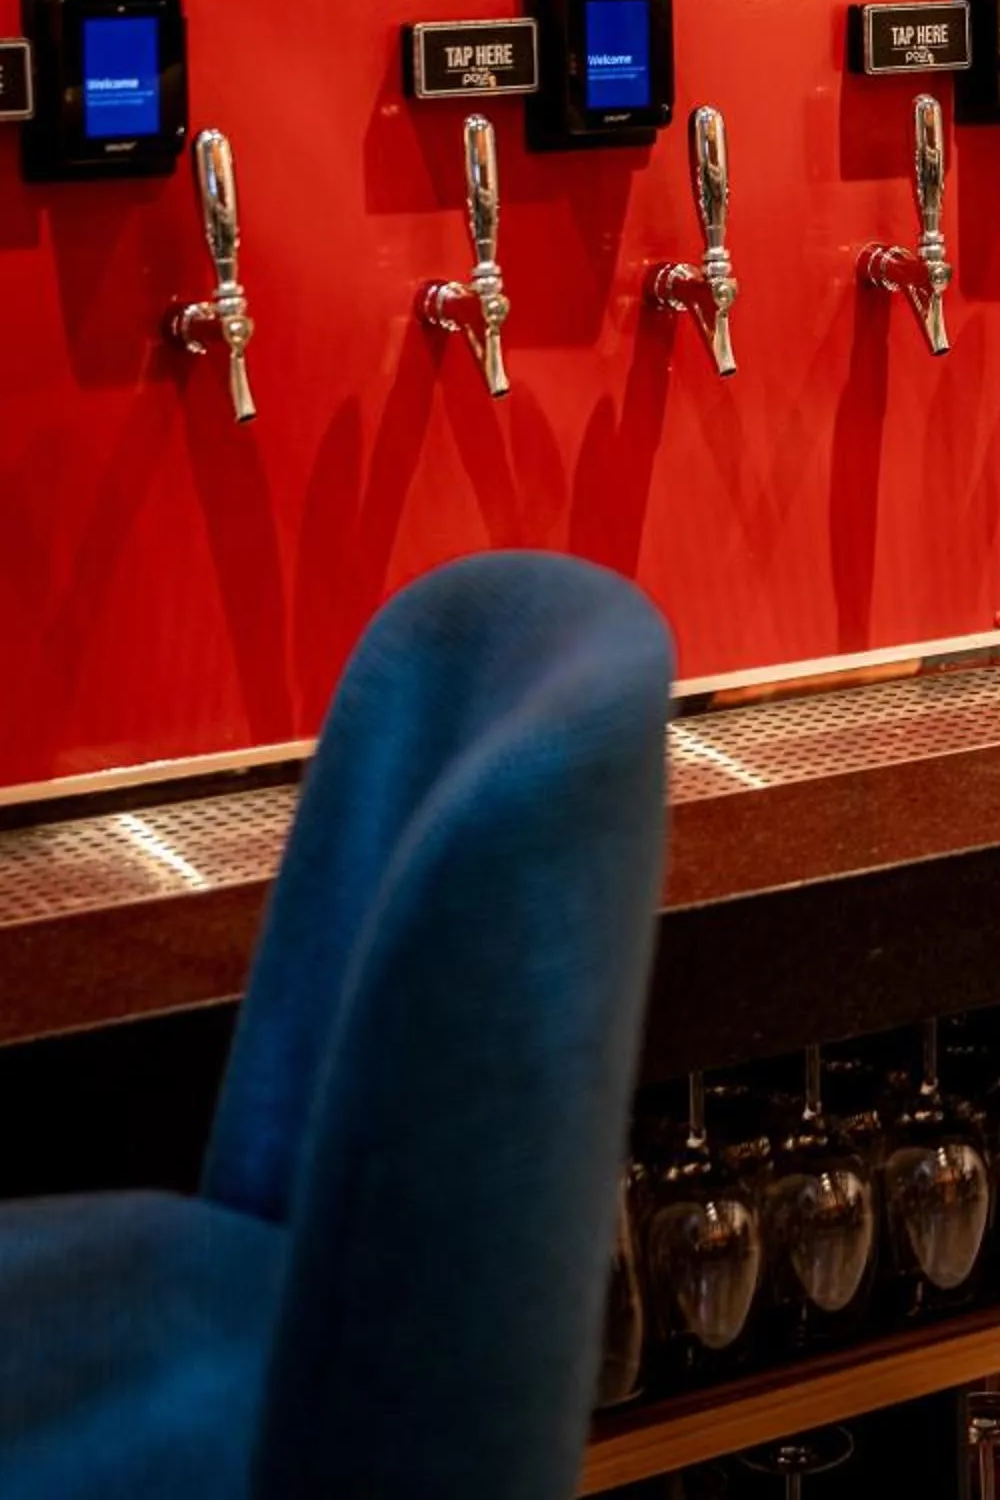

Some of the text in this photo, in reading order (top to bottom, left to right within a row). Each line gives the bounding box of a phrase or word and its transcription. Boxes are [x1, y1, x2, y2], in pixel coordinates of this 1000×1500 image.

[891, 24, 948, 46] TAP HERE
[444, 43, 513, 67] TAP HERE
